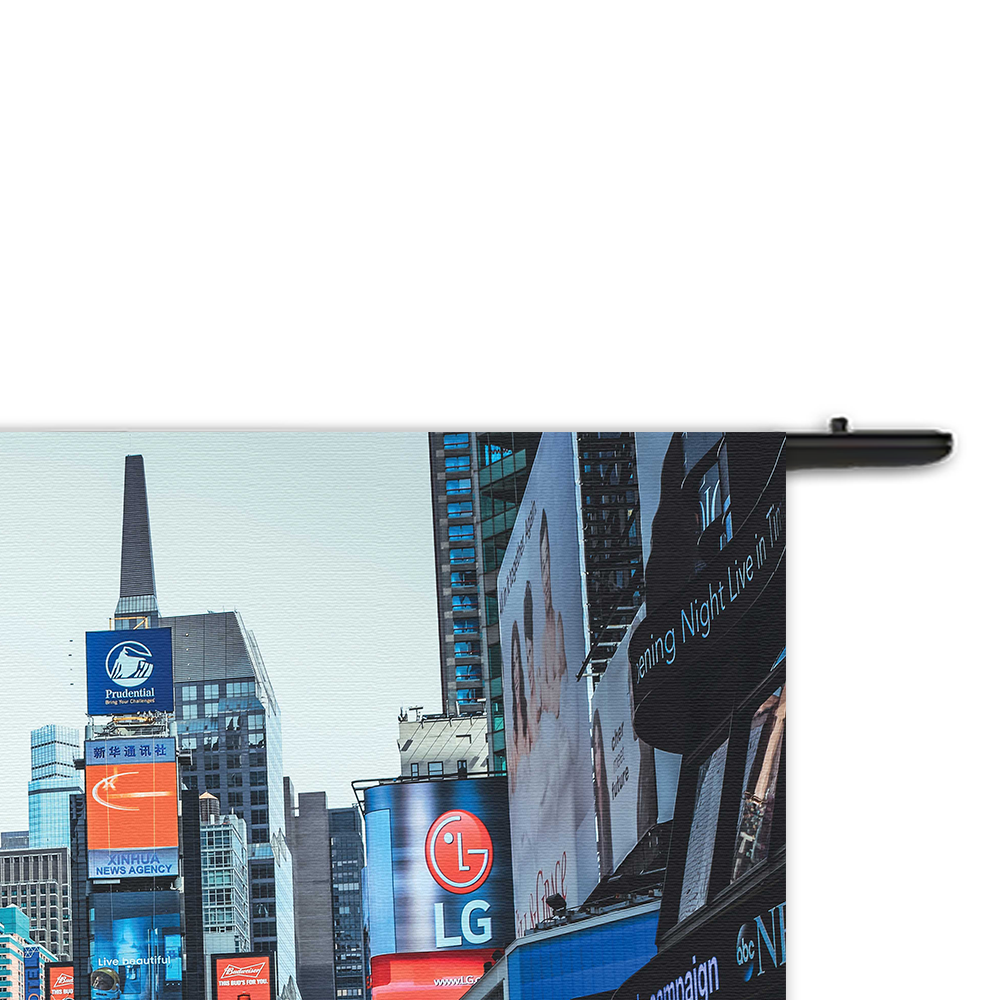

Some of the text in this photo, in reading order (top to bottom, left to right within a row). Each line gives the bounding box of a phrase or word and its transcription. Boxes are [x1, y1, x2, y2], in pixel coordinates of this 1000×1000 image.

[681, 581, 726, 643] Night
[728, 555, 754, 602] Live
[755, 533, 767, 569] in
[105, 687, 155, 699] Prudential
[93, 744, 167, 759] 新华通讯社
[108, 852, 160, 866] XINHUA
[96, 864, 173, 876] NEWS AGENCY
[434, 899, 493, 948] LG
[736, 937, 756, 966] abc
[98, 955, 171, 966] Live beautiful
[224, 966, 261, 976] Budweiser
